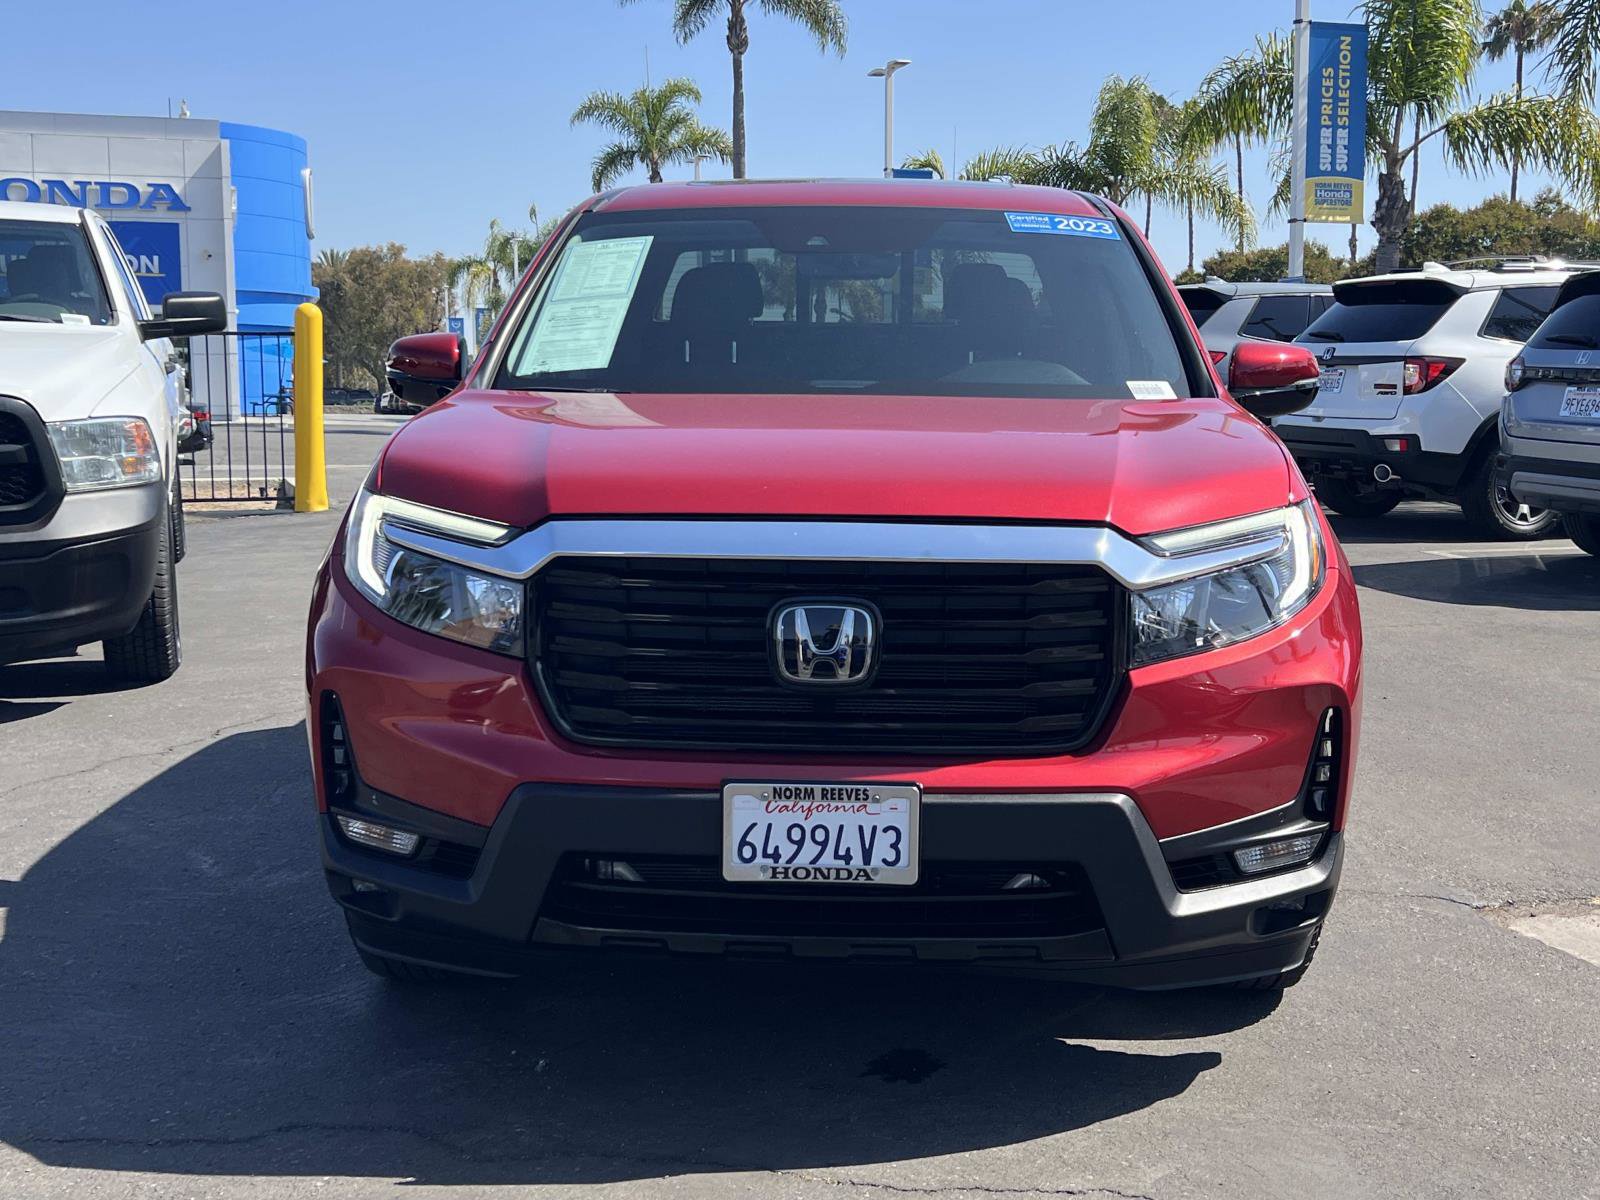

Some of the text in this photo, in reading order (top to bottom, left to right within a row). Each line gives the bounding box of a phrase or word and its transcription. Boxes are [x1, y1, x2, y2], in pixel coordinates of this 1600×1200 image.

[1336, 35, 1352, 172] SUPER SELECTION
[1320, 67, 1334, 172] SUPER PRICES
[1317, 189, 1350, 199] Honda
[1054, 217, 1113, 234] 2023
[1563, 398, 1600, 413] 9FYE696
[773, 786, 870, 801] NORM REEVES
[765, 800, 881, 821] California
[737, 822, 902, 867] 64994V3
[769, 866, 874, 881] HONDA
